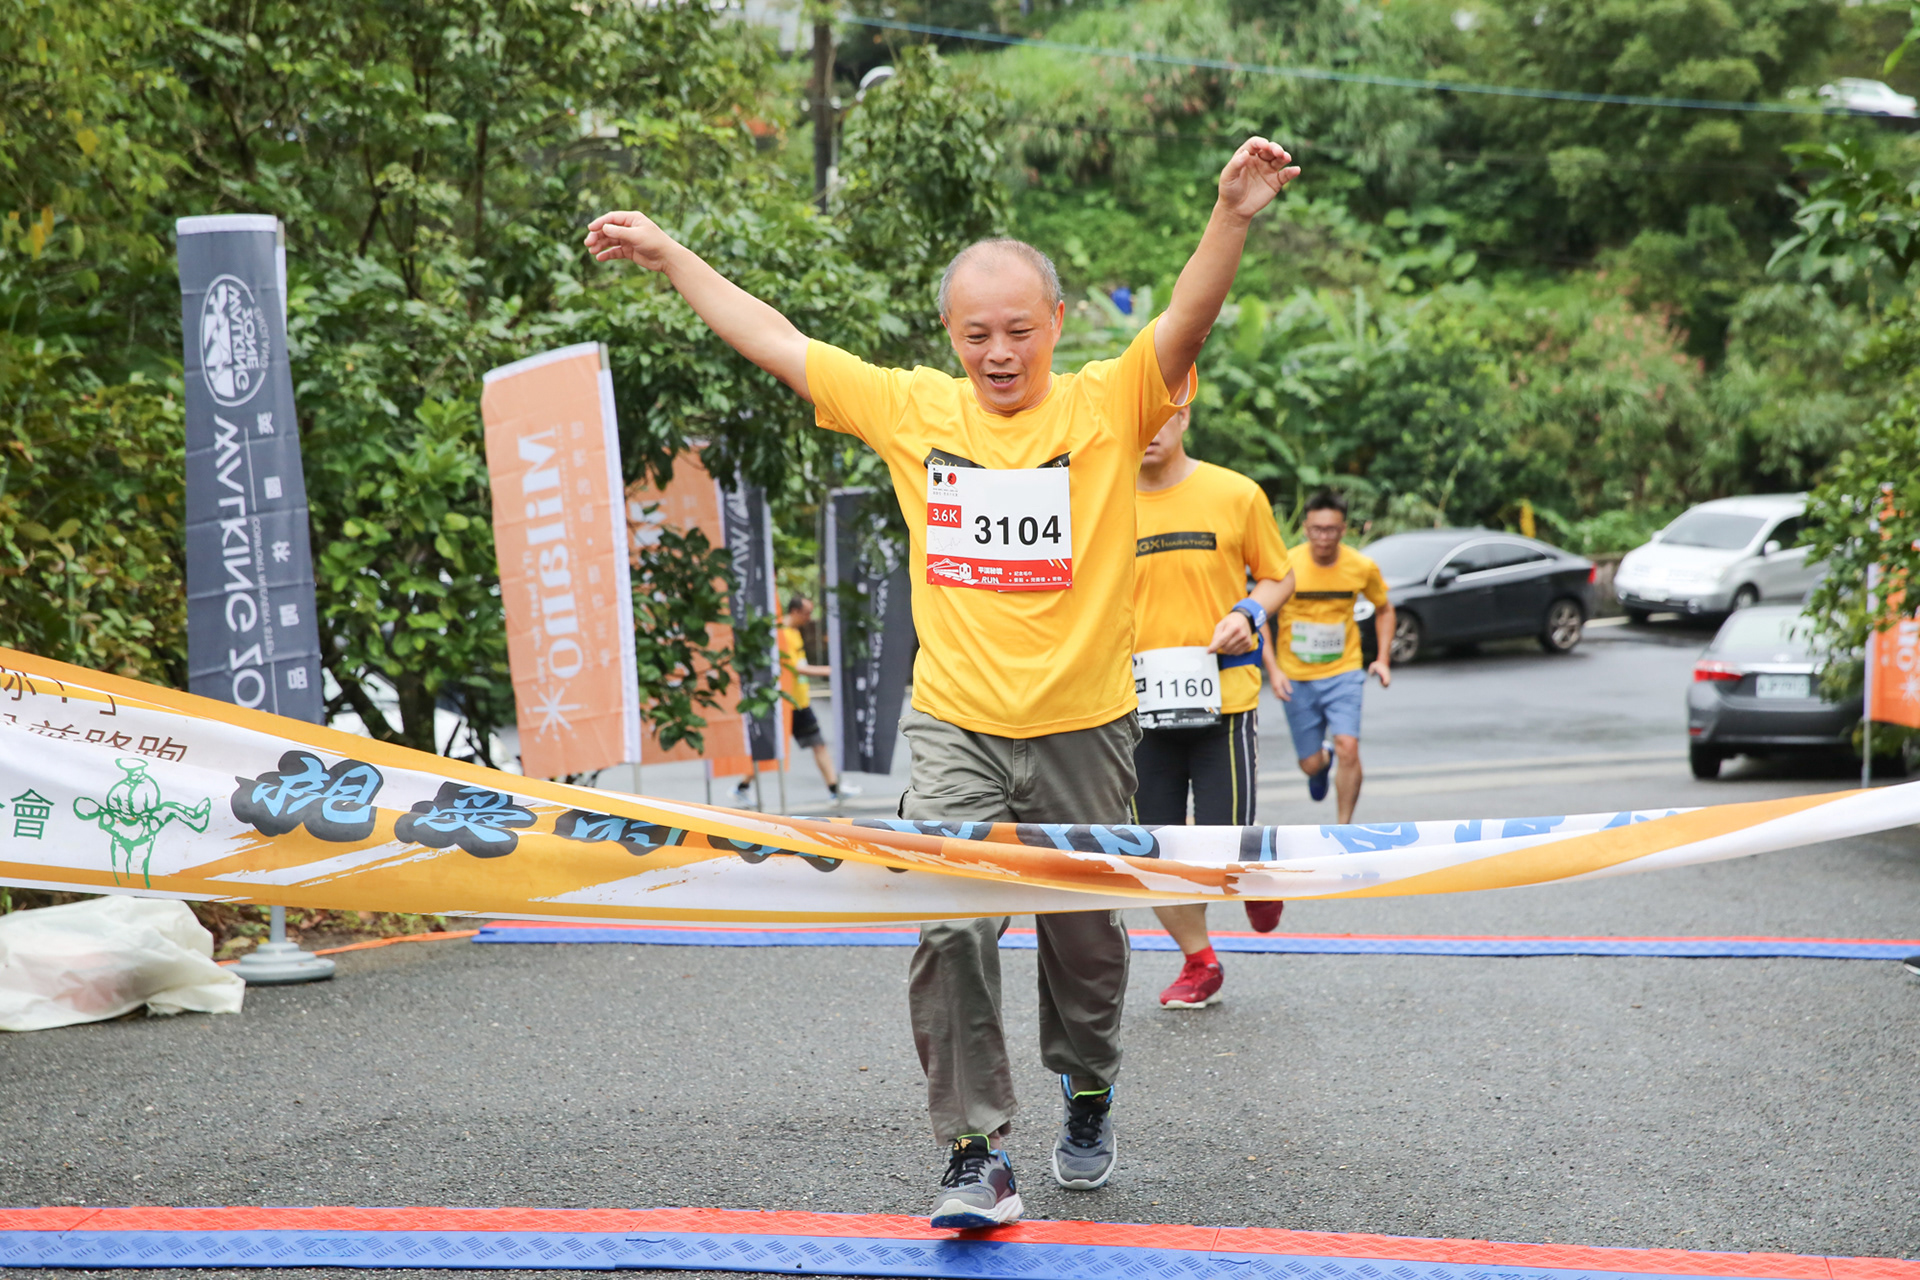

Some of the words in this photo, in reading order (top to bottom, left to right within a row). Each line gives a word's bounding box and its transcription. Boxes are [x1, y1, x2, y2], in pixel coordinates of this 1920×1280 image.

[932, 508, 959, 523] 3.6K
[974, 515, 1062, 546] 3104
[981, 576, 1000, 585] RUN
[1155, 678, 1214, 699] 1160
[0, 788, 55, 840] 會
